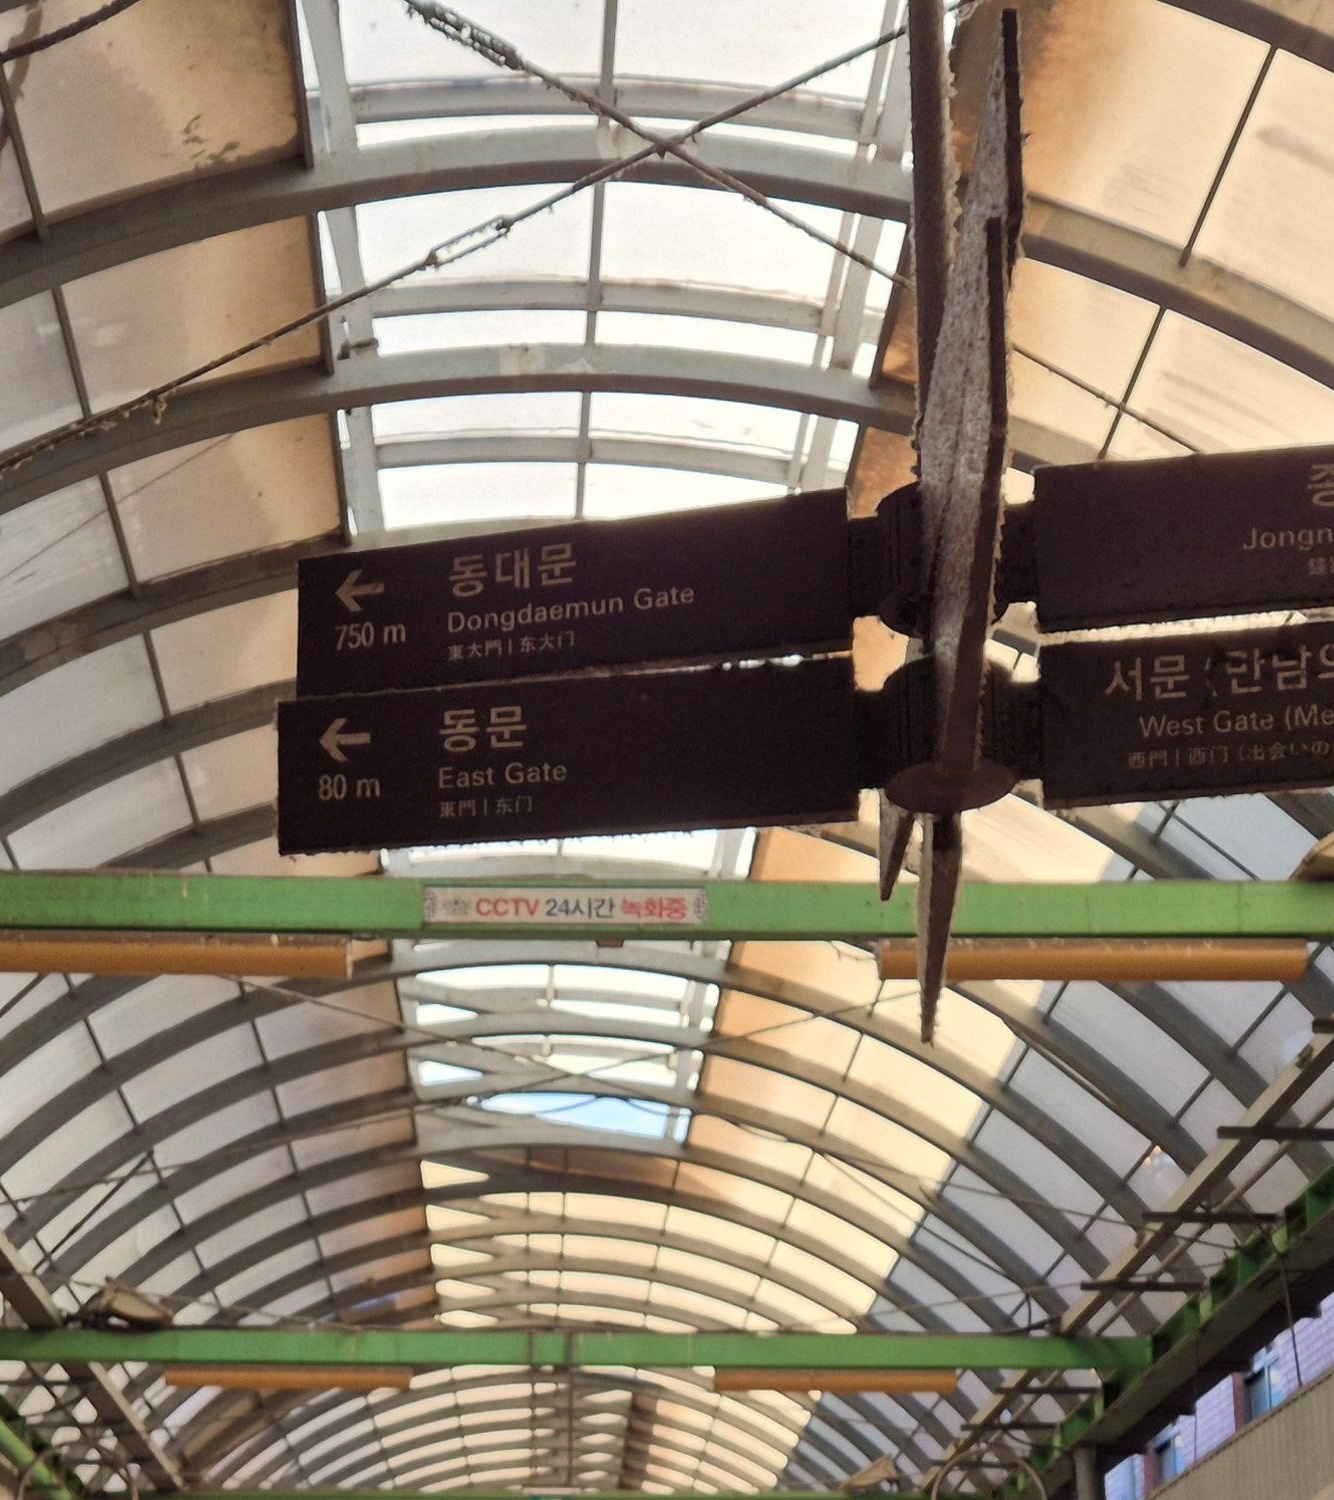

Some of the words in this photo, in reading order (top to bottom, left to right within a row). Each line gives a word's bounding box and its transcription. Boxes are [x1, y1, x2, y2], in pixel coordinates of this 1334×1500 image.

[448, 543, 576, 598] 동대문
[448, 598, 623, 633] Dongdaemun
[634, 586, 694, 609] Gate
[335, 622, 375, 651] 750
[384, 624, 406, 643] m
[448, 640, 502, 661] 東大門
[520, 630, 575, 652] 东大门
[1106, 654, 1190, 701] 서문
[439, 706, 527, 753] 동문
[1139, 715, 1204, 738] West
[1213, 710, 1274, 733] Gate
[319, 775, 346, 800] 80
[356, 780, 380, 798] m
[439, 767, 495, 789] East
[505, 761, 567, 788] Gate
[495, 796, 533, 815] 东门
[476, 898, 538, 917] CCTV
[545, 897, 615, 919] 24시간
[622, 898, 687, 919] 녹화중
